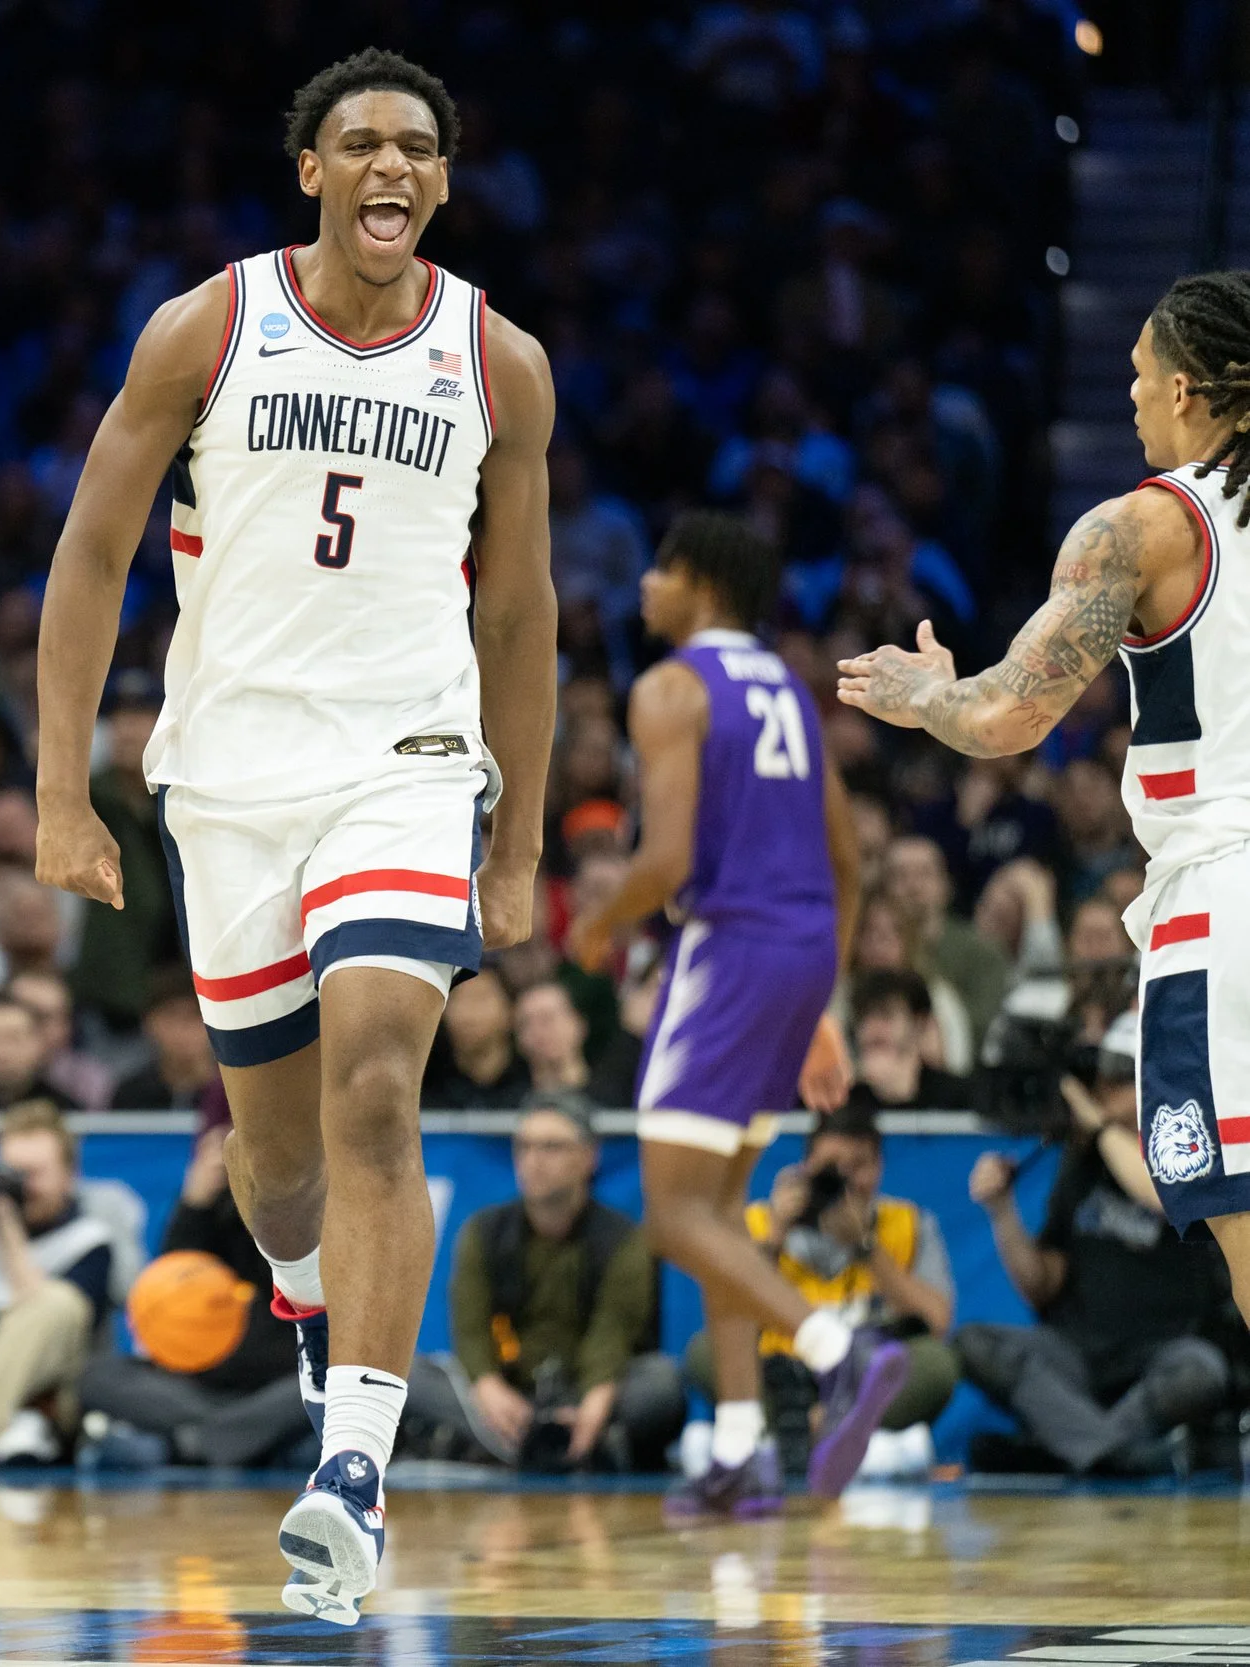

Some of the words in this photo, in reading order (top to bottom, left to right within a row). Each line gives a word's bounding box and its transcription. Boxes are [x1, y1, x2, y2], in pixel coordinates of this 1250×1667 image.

[429, 386, 465, 398] EAST
[434, 378, 460, 389] BIG
[248, 393, 456, 477] CONNECTICUT
[314, 471, 364, 570] 5
[445, 741, 459, 749] 52
[746, 684, 810, 781] 21
